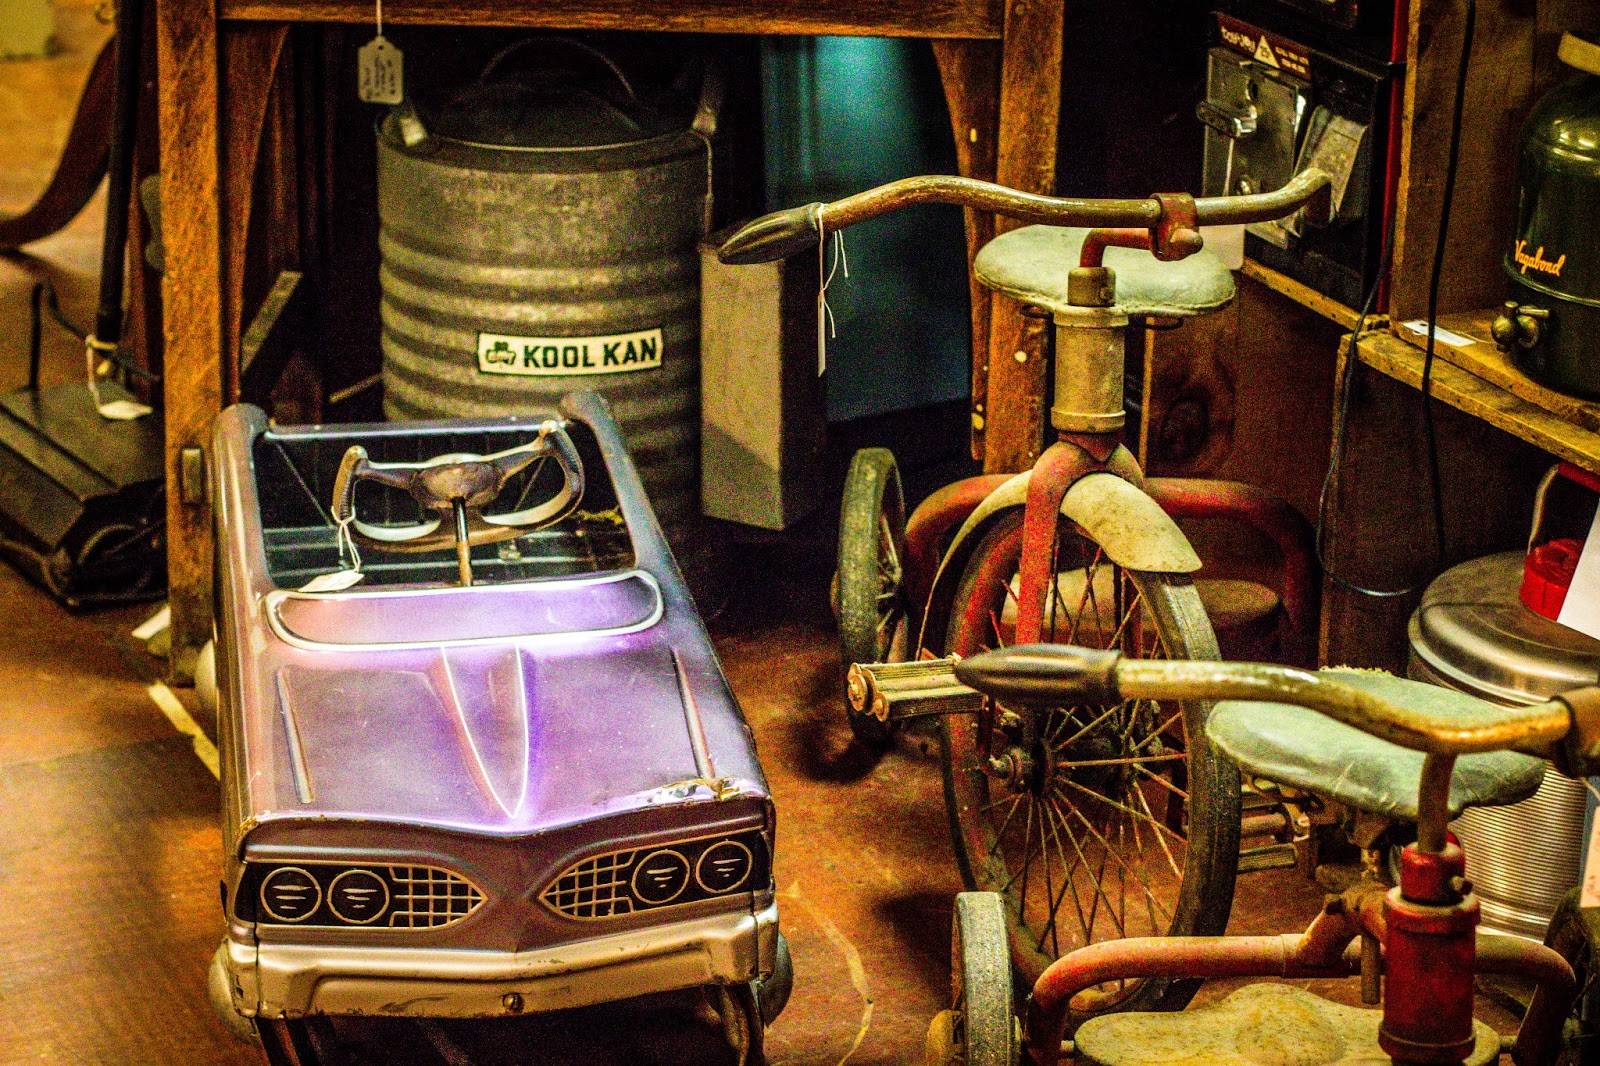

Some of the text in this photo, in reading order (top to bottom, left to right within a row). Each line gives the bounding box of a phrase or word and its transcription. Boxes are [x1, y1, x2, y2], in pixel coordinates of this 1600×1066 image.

[1515, 240, 1567, 277] Vagabond
[523, 337, 657, 368] KOOL KAN
